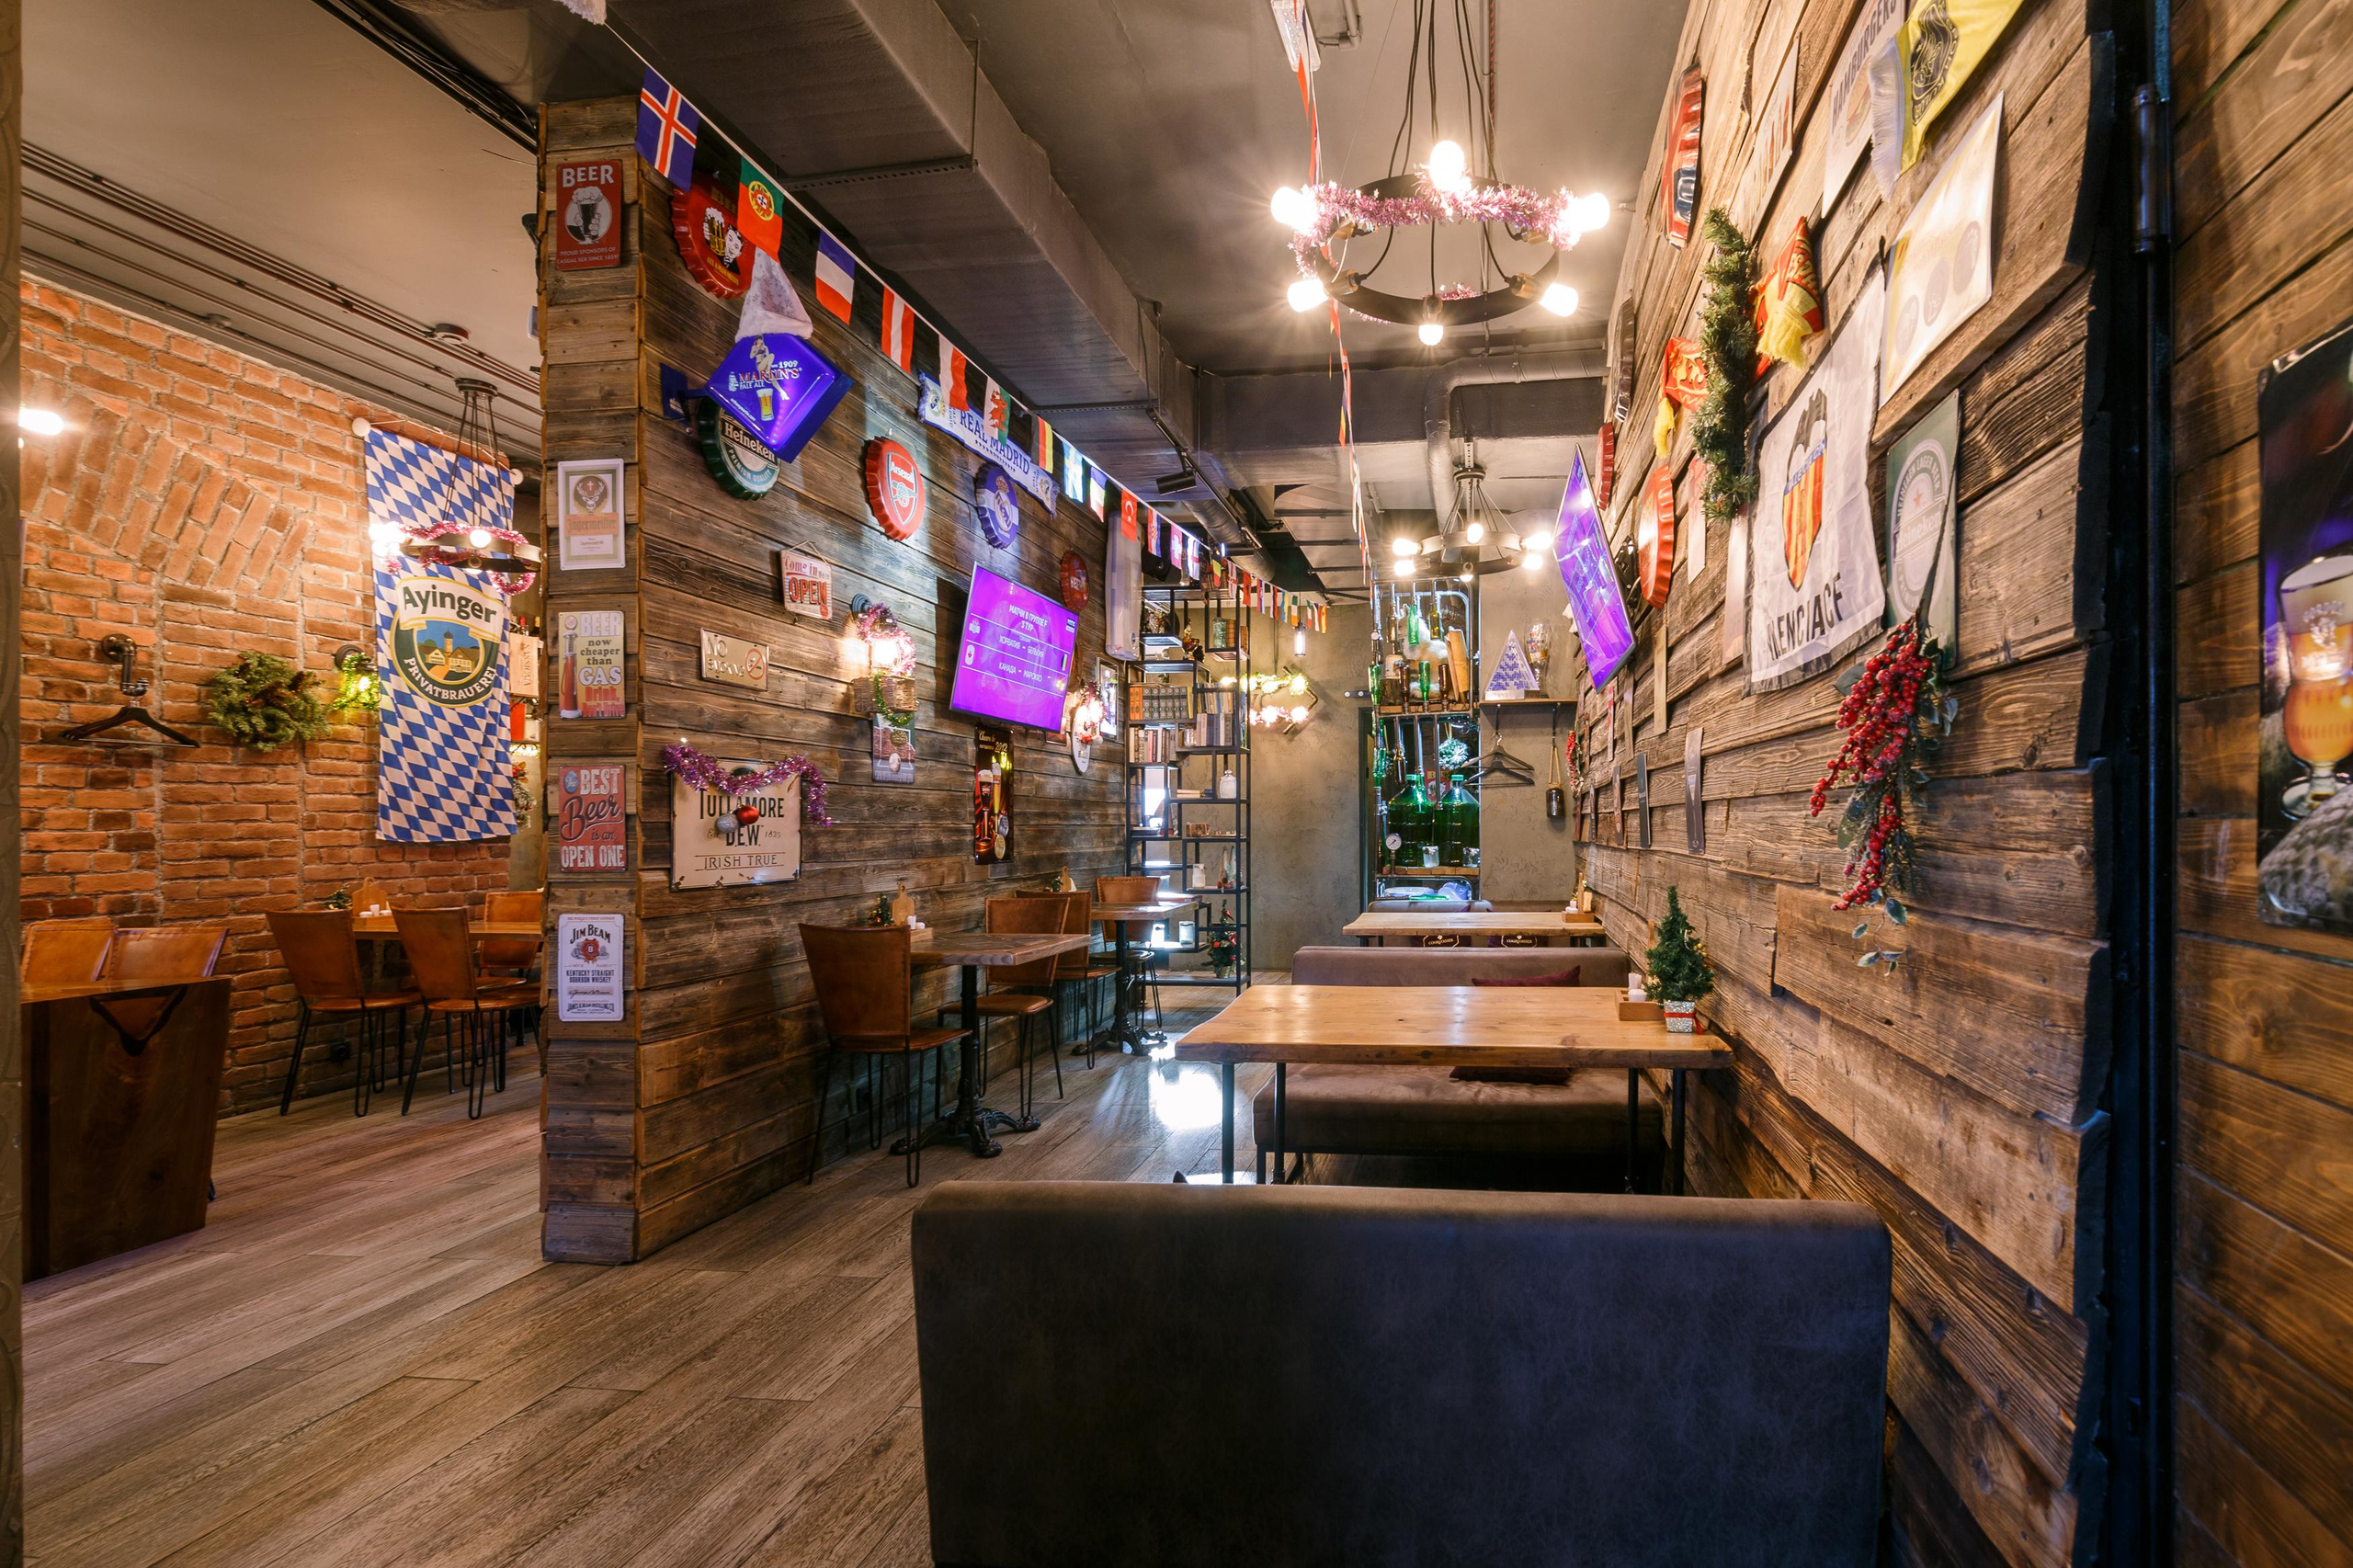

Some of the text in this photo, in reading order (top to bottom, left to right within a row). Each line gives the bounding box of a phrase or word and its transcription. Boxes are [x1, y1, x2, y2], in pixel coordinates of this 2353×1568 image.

[563, 165, 614, 187] BEER
[739, 368, 800, 383] MARTIN'S
[739, 381, 753, 390] PALE
[724, 422, 775, 461] Heineken
[960, 409, 988, 442] REAL
[990, 436, 1030, 475] MADRID
[728, 449, 772, 483] PREMIUM QUALITY
[891, 461, 914, 483] Arsenal
[810, 562, 818, 576] in
[789, 577, 827, 605] OPEN
[403, 584, 497, 623] Ayinger
[580, 613, 621, 637] BEER
[581, 647, 620, 656] cheaper
[708, 636, 727, 657] NO
[586, 656, 612, 665] than
[404, 657, 497, 700] PRIVATBRAUEREI
[579, 666, 622, 686] GAS
[580, 768, 620, 795] BEST
[561, 795, 622, 842] Beer
[591, 828, 615, 840] is an
[561, 845, 624, 868] OPEN ONE
[704, 855, 778, 869] IRISH TRUE
[570, 924, 610, 944] JIM BEAM
